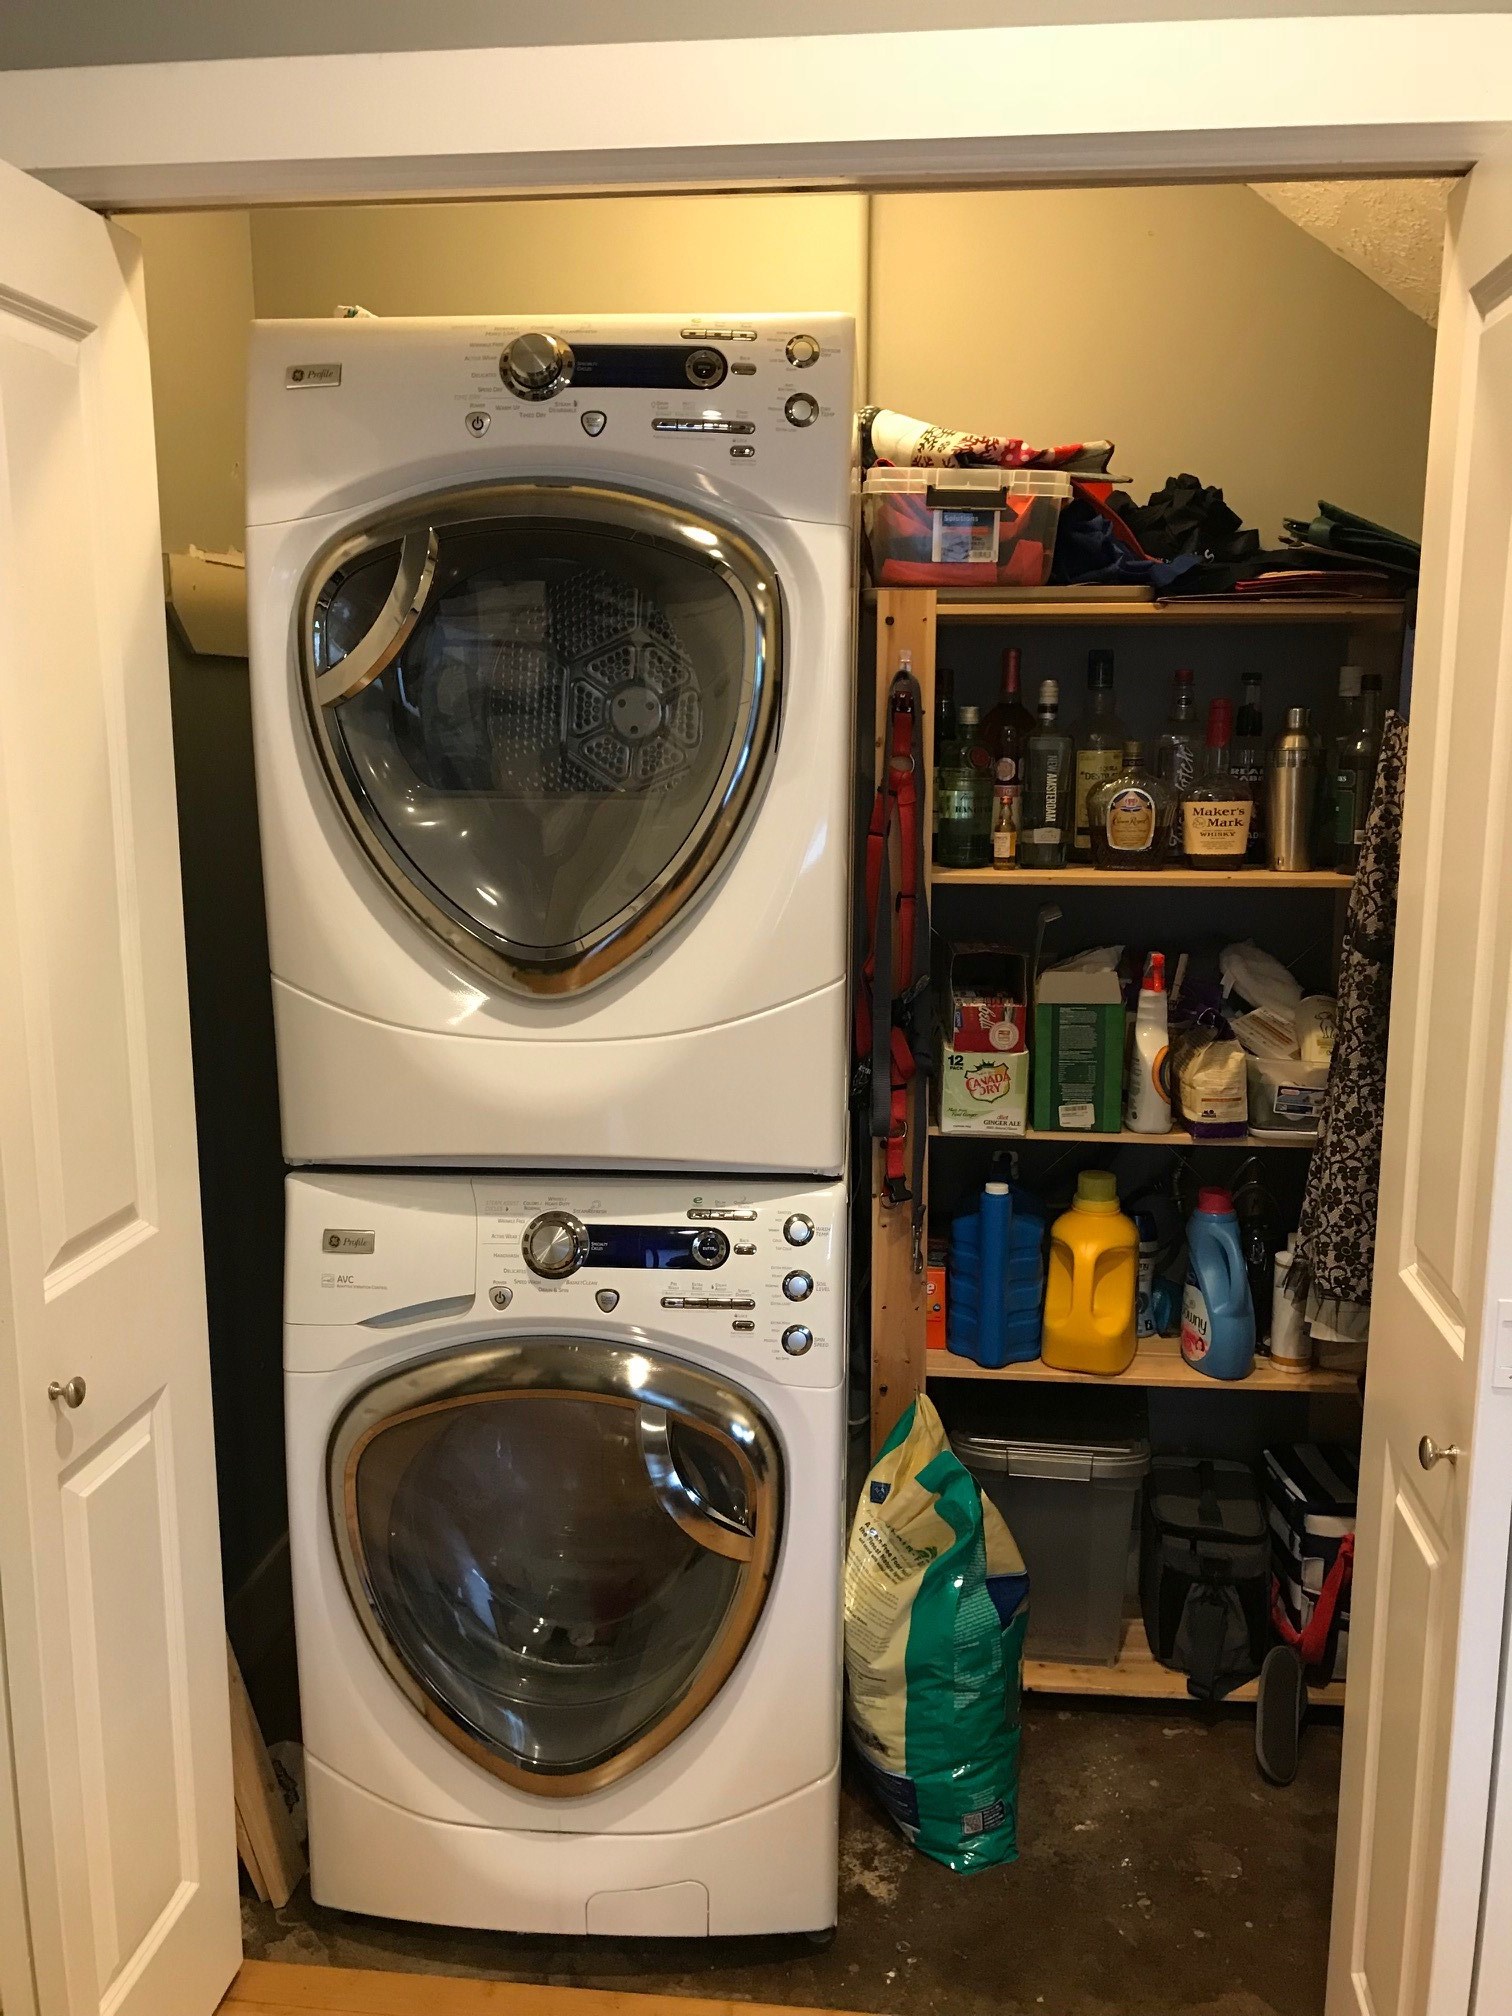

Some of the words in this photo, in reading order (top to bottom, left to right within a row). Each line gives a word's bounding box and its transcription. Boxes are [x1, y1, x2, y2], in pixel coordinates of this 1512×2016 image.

[307, 368, 334, 381] Profile
[943, 514, 979, 523] Solutions
[1045, 773, 1058, 823] AMSTERDAM
[1192, 806, 1245, 817] Maker's
[1207, 817, 1244, 828] Mark
[1199, 831, 1236, 839] WHISKY
[947, 1054, 964, 1067] 12
[966, 1073, 1011, 1092] CANADA
[983, 1119, 1008, 1127] GINGER
[1008, 1120, 1022, 1128] ALE
[342, 1237, 368, 1249] Profile
[336, 1274, 354, 1284] AVC
